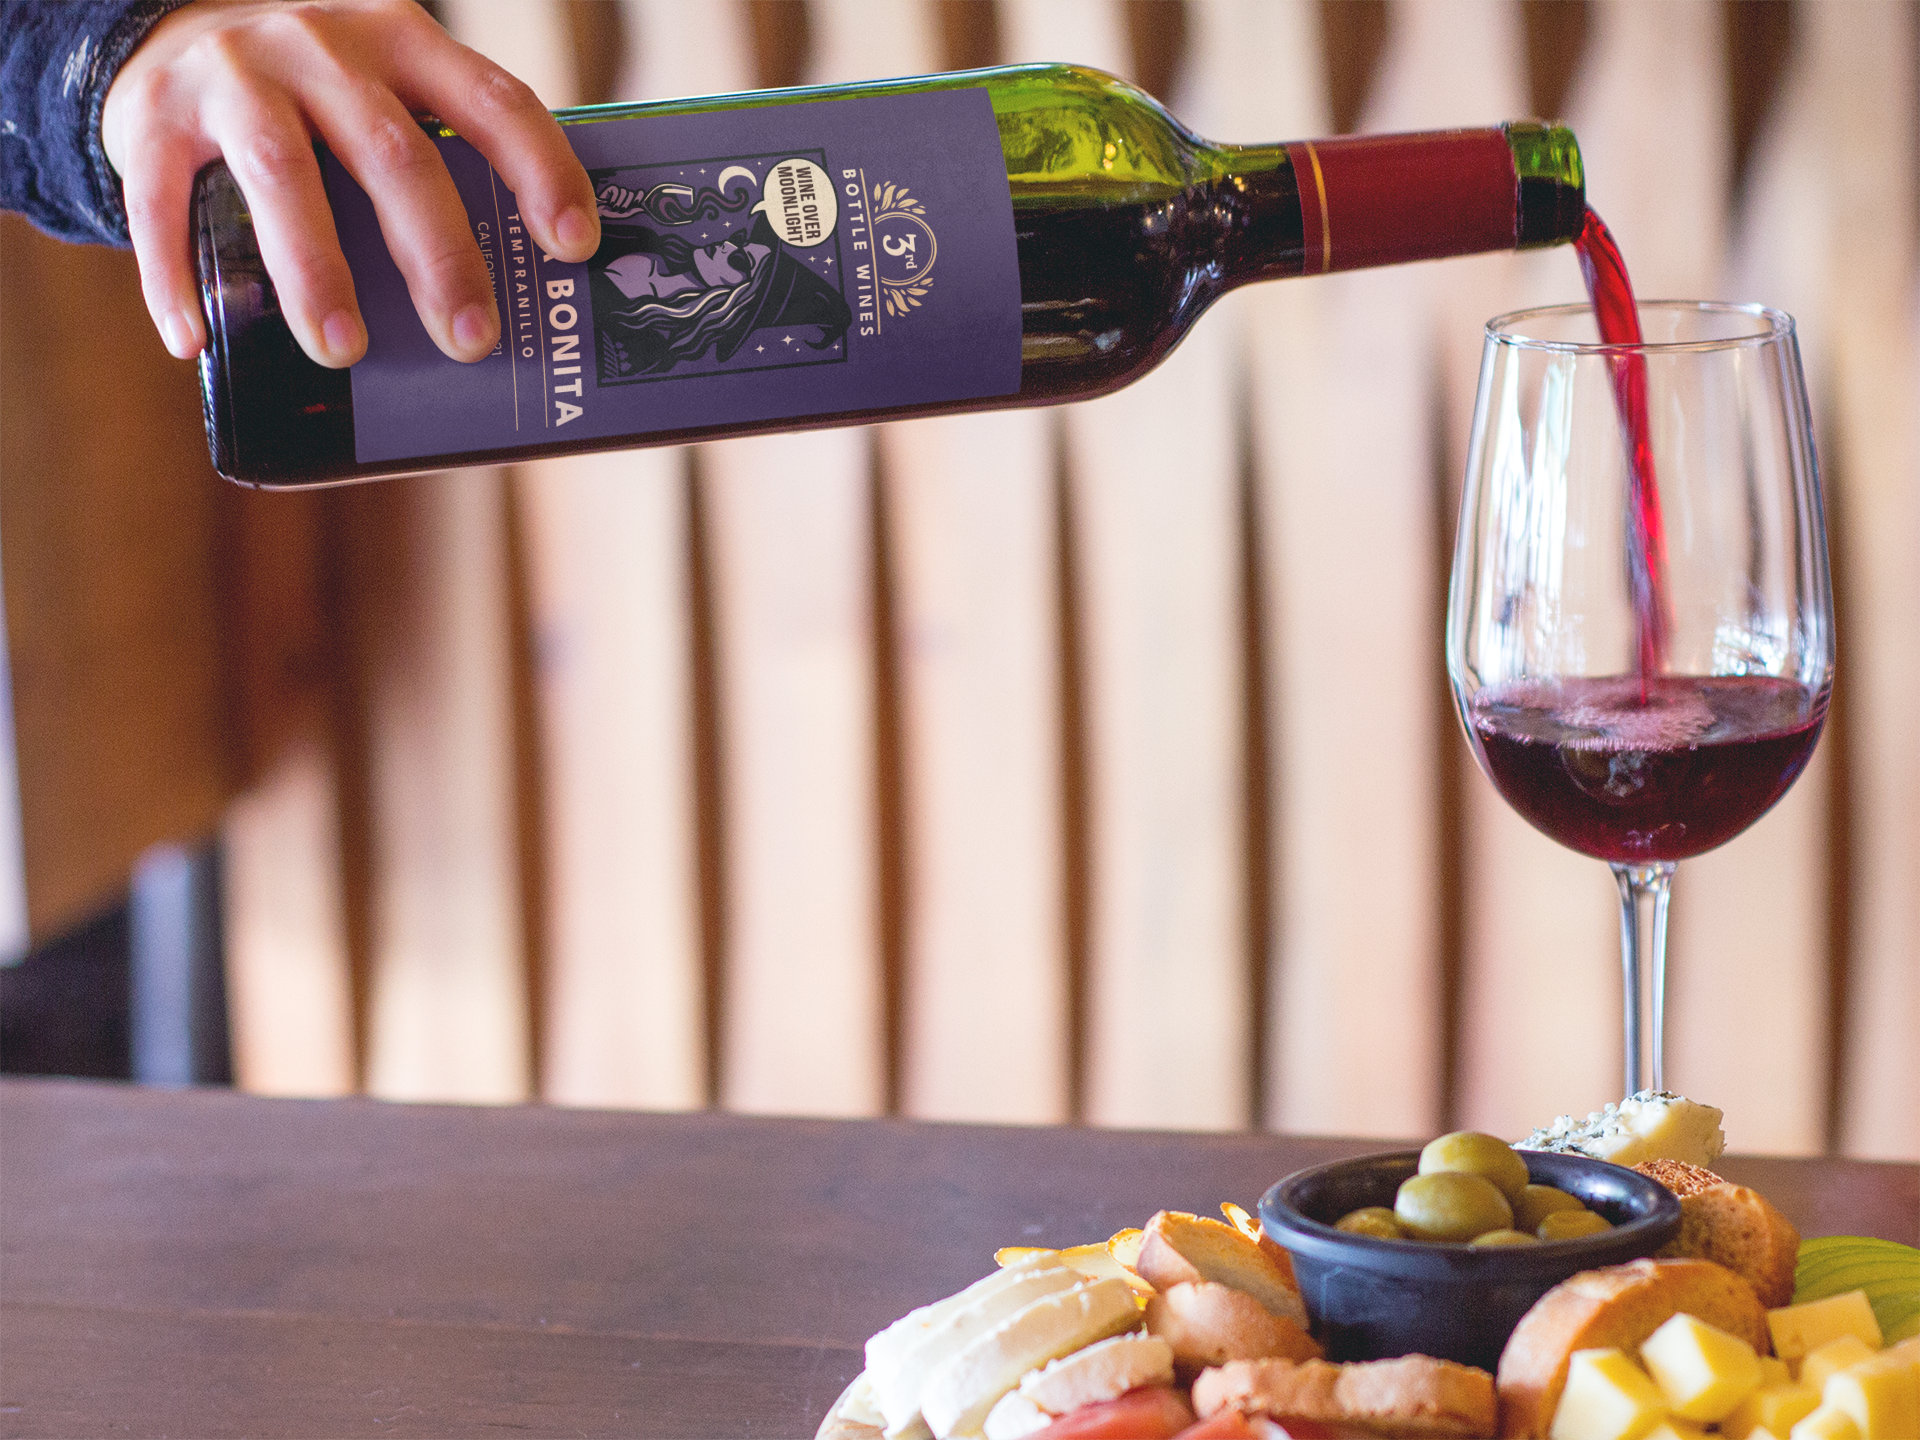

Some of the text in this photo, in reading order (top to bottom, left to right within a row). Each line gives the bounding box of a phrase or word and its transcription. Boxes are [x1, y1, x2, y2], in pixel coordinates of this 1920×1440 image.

[777, 166, 804, 243] MOONLIGHT
[796, 166, 821, 239] WINE OVER
[842, 168, 874, 336] BOTTLE WINES
[882, 233, 918, 270] 3rd
[508, 213, 534, 358] TEMPRANILLO
[546, 278, 584, 428] BONITA
